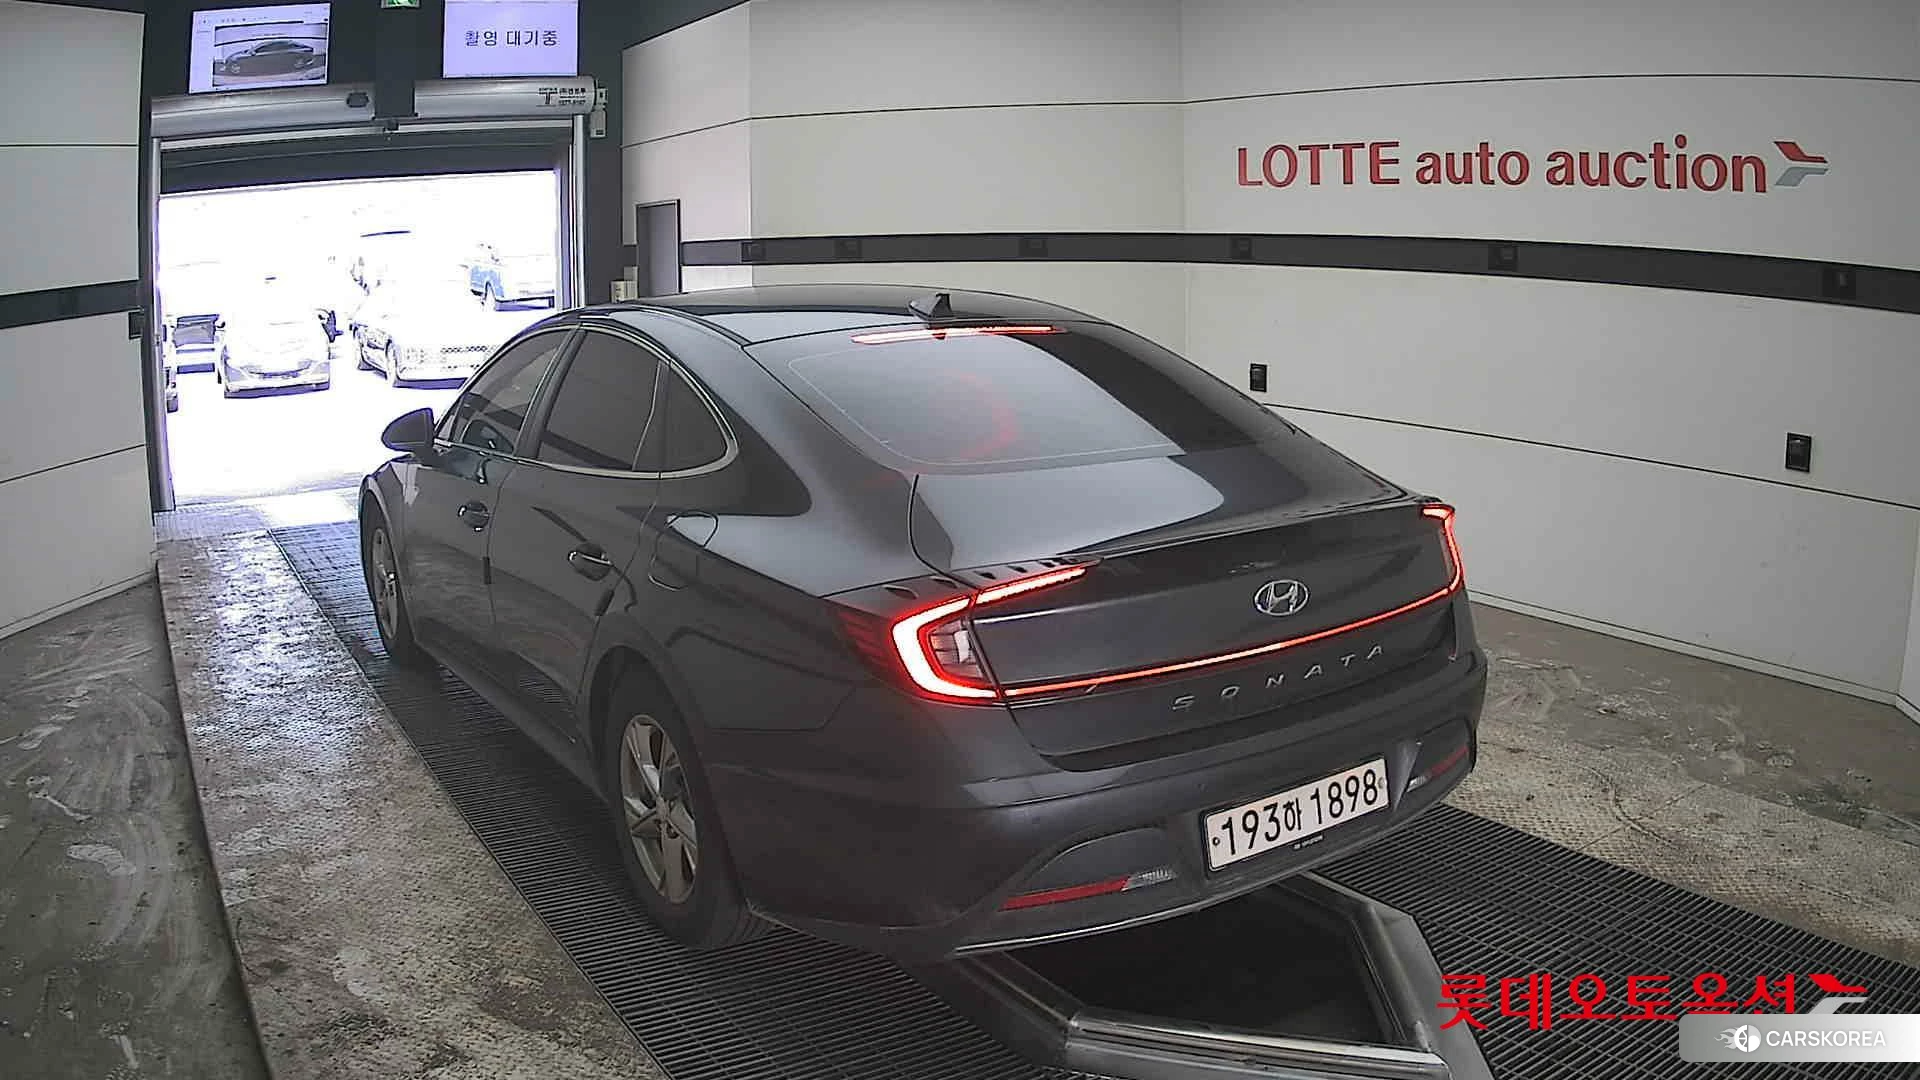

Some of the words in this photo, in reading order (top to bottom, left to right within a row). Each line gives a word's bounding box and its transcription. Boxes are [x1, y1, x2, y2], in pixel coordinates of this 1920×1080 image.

[506, 30, 558, 47] 대기중
[1237, 141, 1400, 187] LOTTE
[1415, 141, 1530, 187] auto
[1545, 134, 1767, 194] auction
[1172, 645, 1384, 711] SONATA
[1221, 797, 1302, 855] 193하
[1310, 769, 1378, 825] 1898
